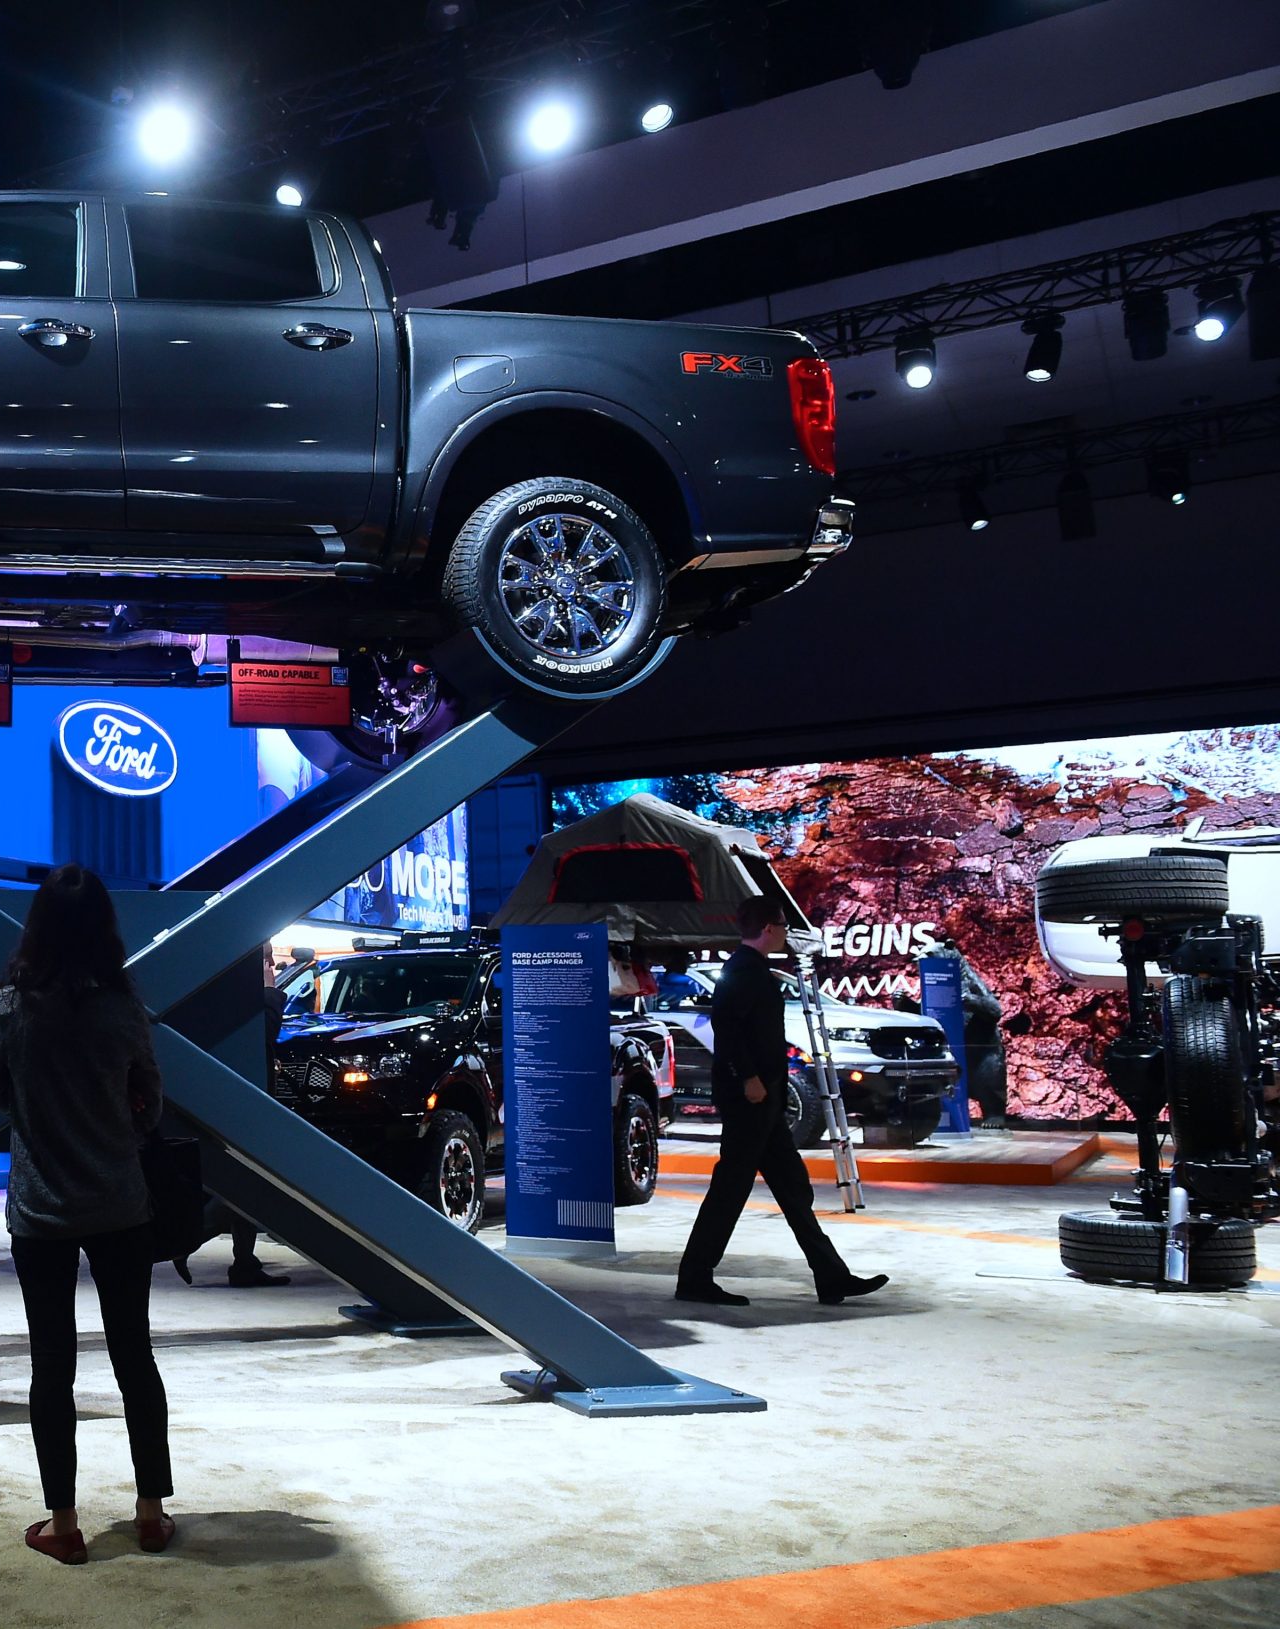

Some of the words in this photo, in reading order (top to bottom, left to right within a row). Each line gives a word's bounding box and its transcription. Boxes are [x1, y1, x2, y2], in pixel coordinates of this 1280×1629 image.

[680, 351, 773, 377] FX4
[518, 494, 584, 515] Dynapro
[238, 668, 280, 679] OFF-ROAD
[281, 669, 320, 680] CAPABLE
[85, 713, 158, 780] Ford
[391, 849, 467, 905] MORE
[397, 903, 418, 922] Tech
[811, 921, 936, 957] EGINS
[532, 951, 582, 959] ACCESSORIES
